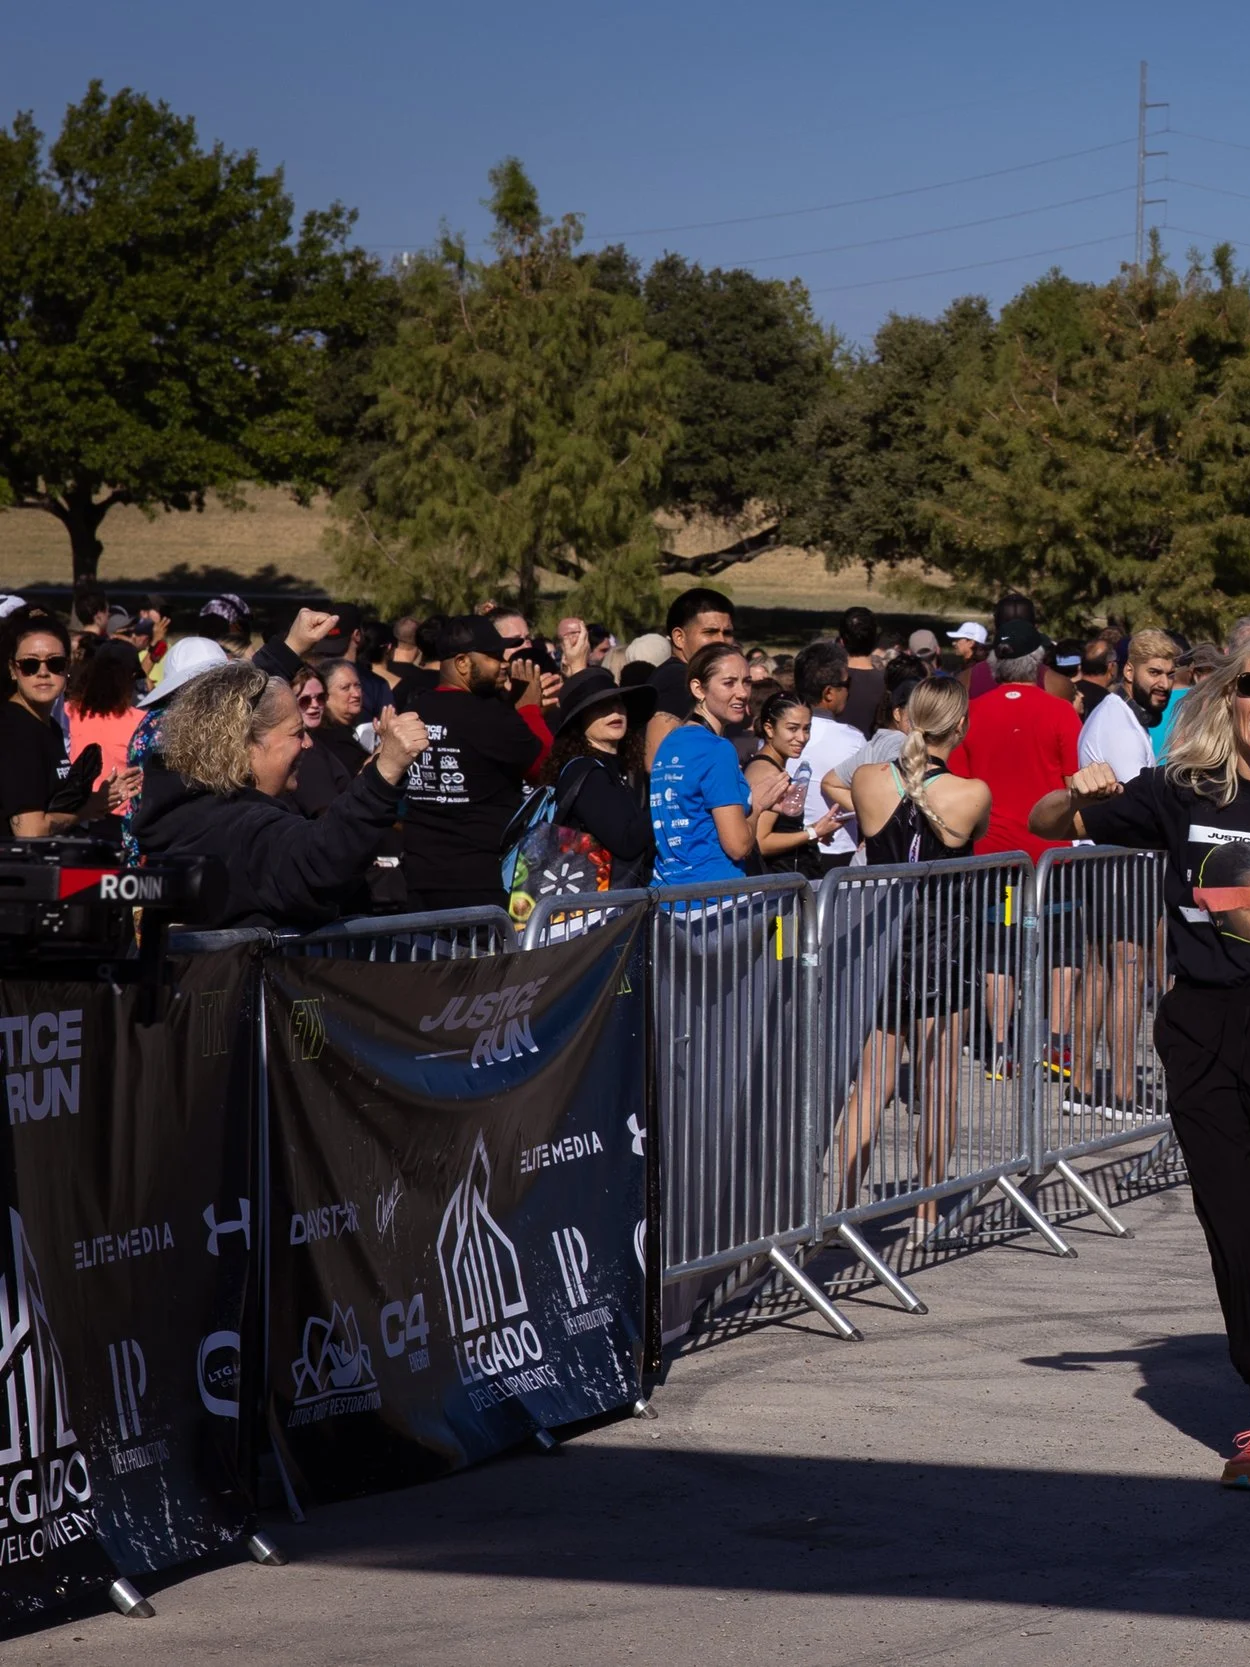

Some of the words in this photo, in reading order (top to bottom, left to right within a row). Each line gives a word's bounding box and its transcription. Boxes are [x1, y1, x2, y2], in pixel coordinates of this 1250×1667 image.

[419, 976, 549, 1032] JUSTICE
[471, 1014, 540, 1069] RUN
[6, 1064, 80, 1125] RUN
[520, 1143, 551, 1174] ELITE
[551, 1130, 604, 1164] MEDIA
[73, 1235, 116, 1270] ELITE
[116, 1221, 175, 1260] MEDIA
[380, 1292, 430, 1358] C4
[453, 1320, 542, 1386] LEGADO
[468, 1363, 560, 1412] DEVELOPMENTS
